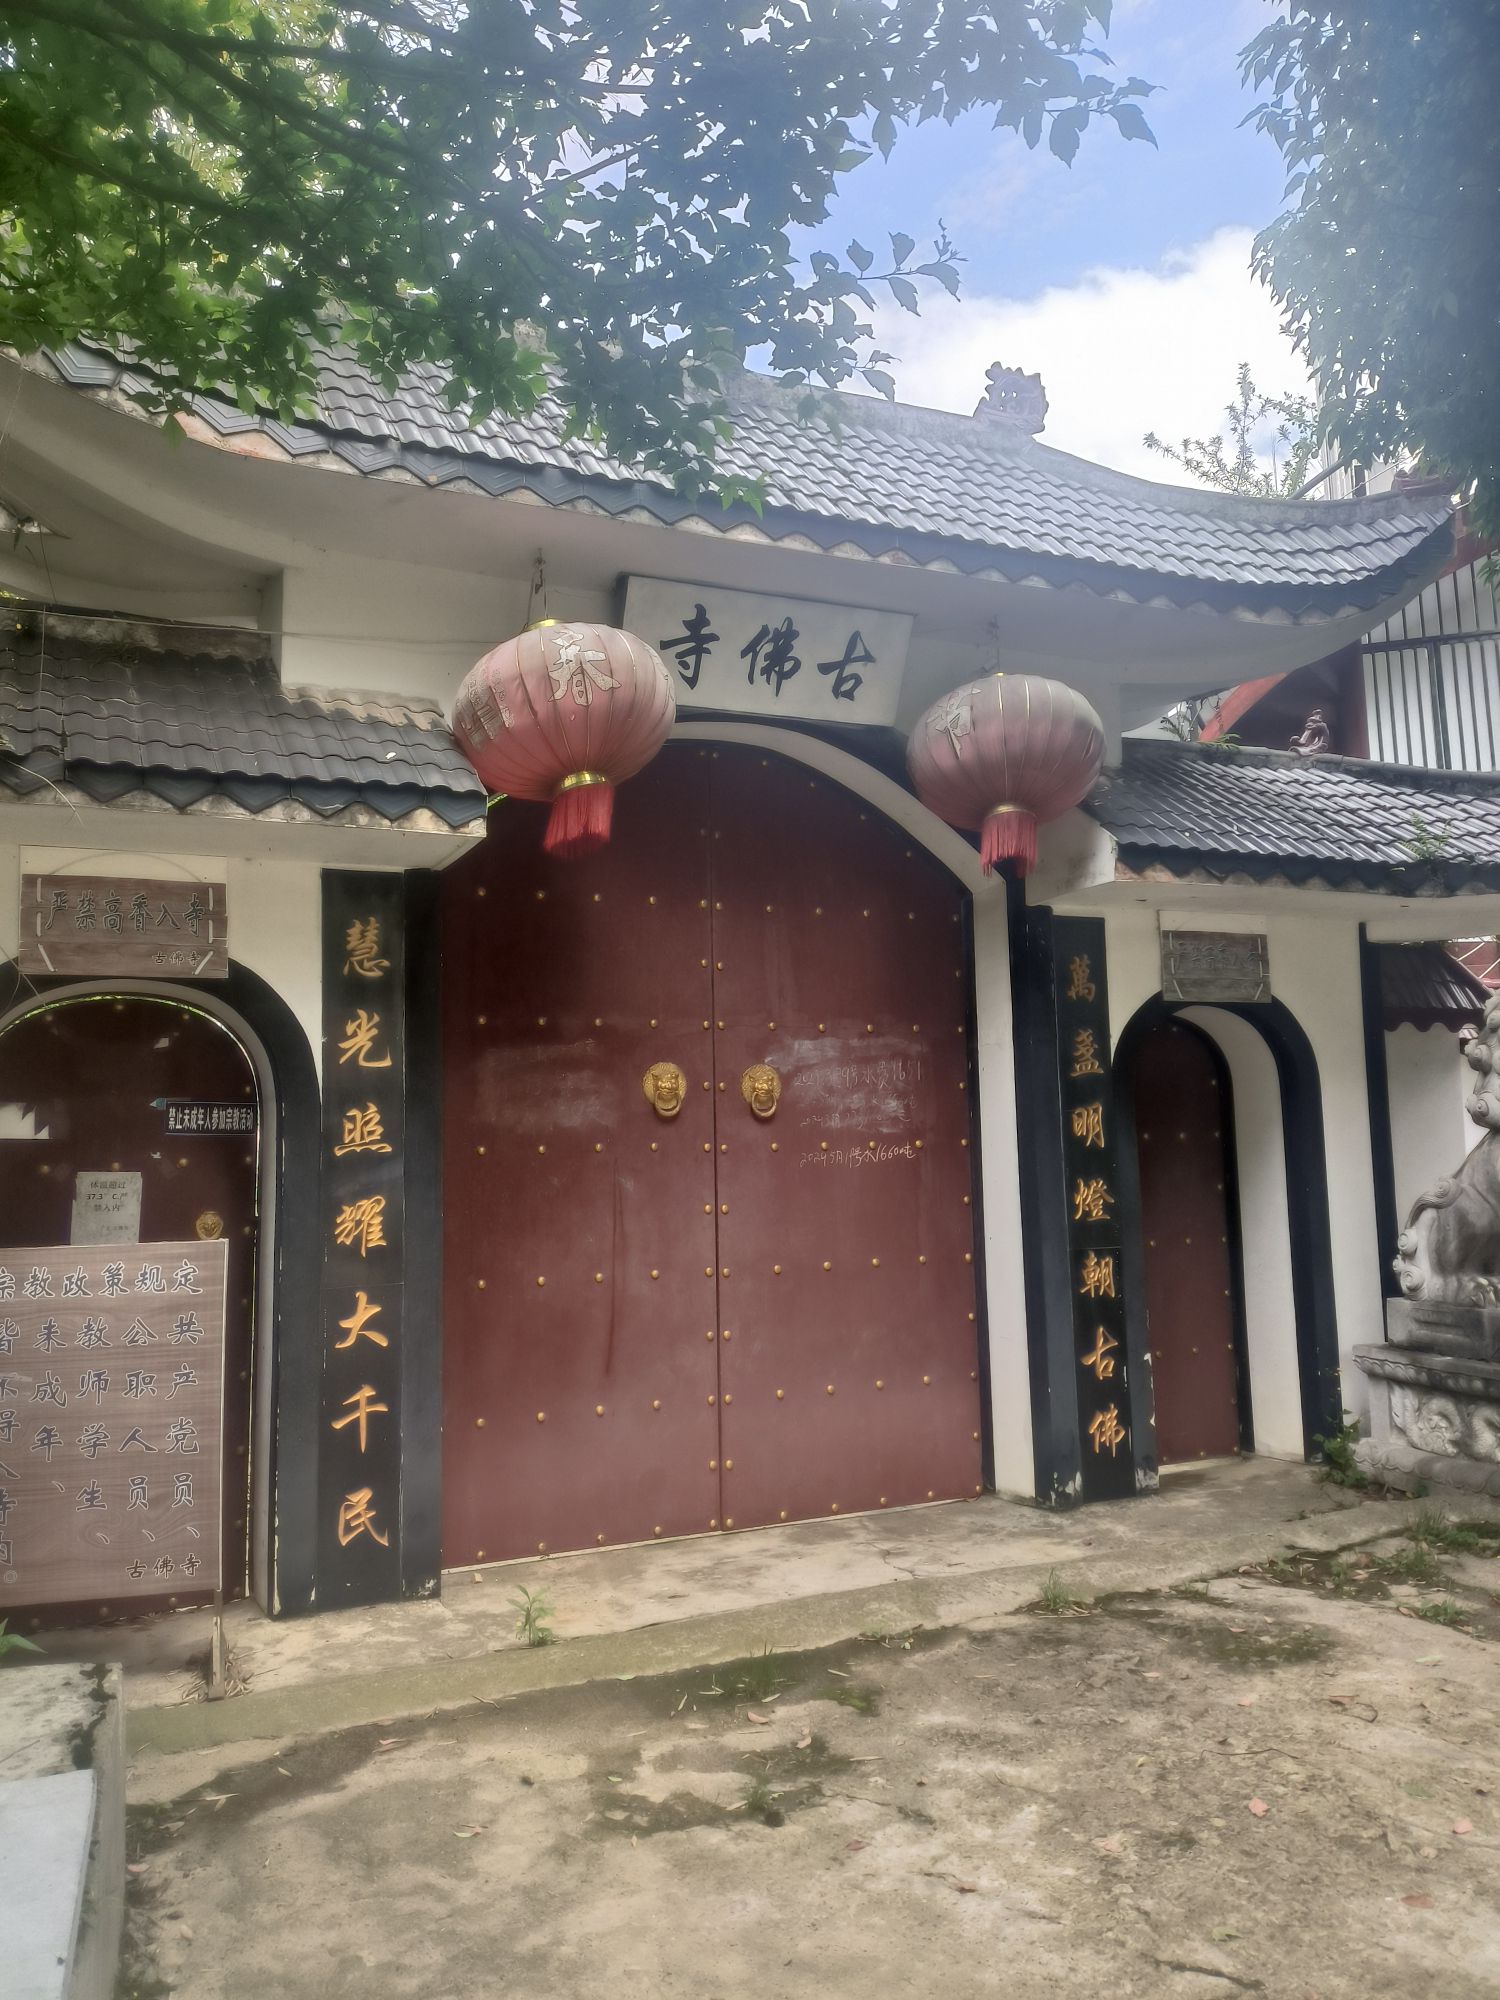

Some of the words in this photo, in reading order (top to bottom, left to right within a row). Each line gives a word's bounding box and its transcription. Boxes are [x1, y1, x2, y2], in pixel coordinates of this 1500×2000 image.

[45, 889, 206, 937] 严禁高香入寺
[152, 951, 200, 966] 古佛寺
[168, 1106, 254, 1131] 禁止未成年人参加宗教活动
[330, 916, 393, 1547] 慧光照耀大千民
[126, 1553, 201, 1579] 古佛寺
